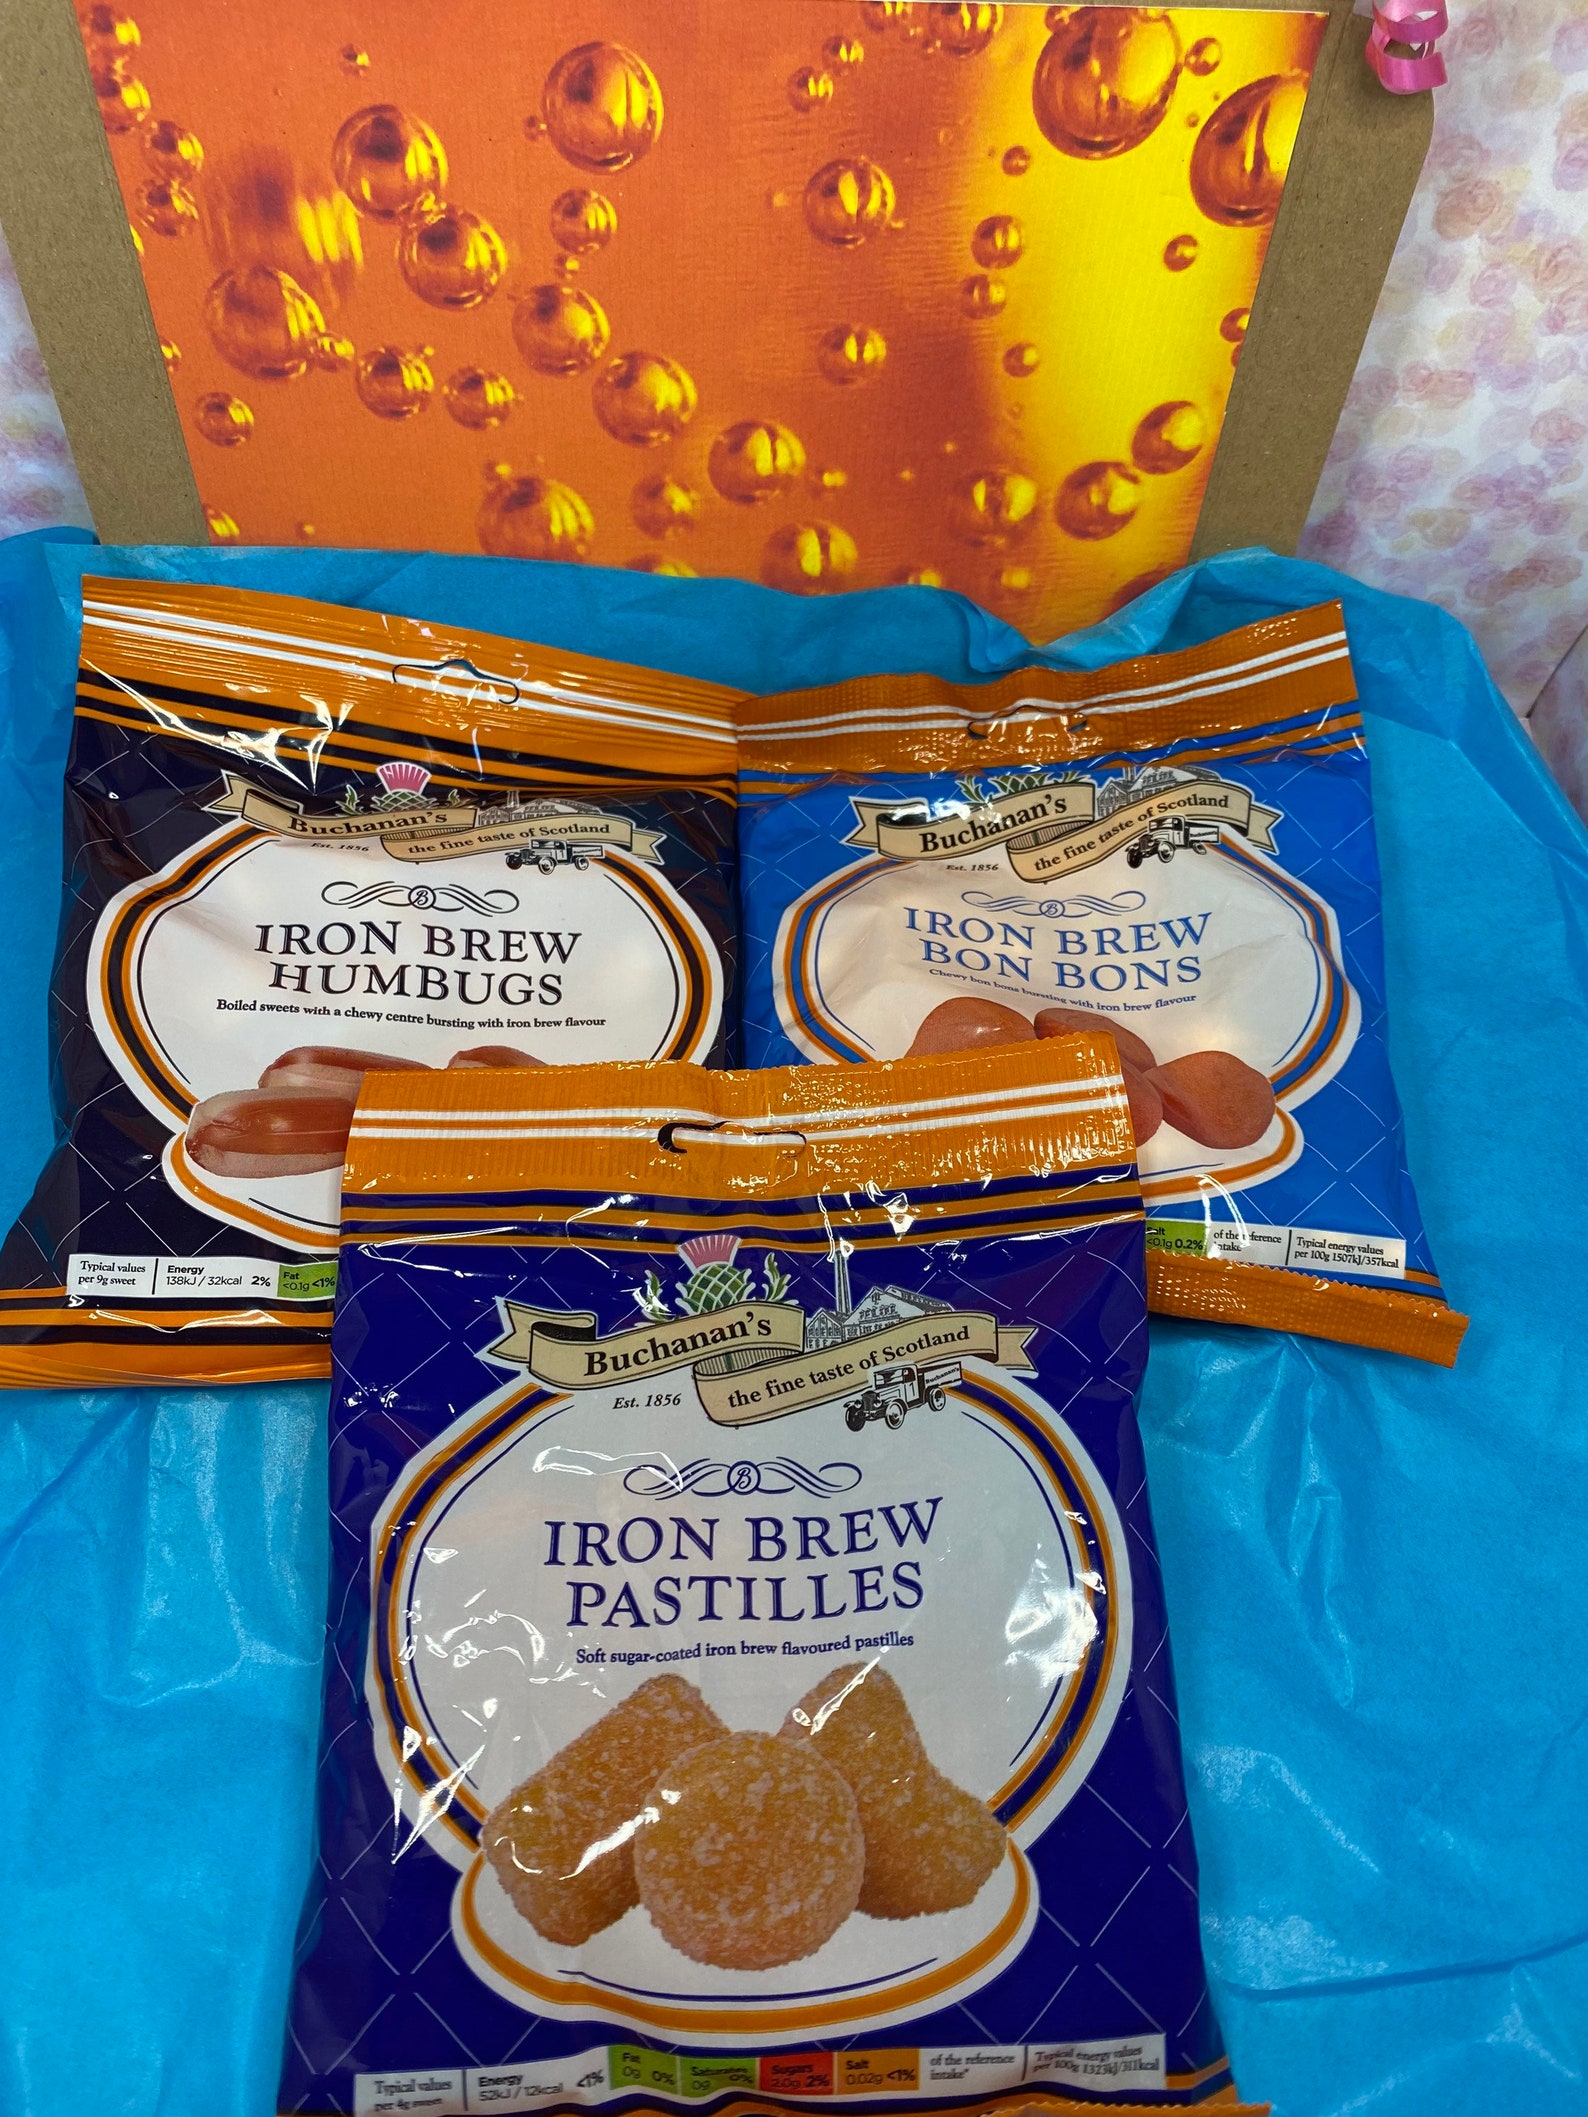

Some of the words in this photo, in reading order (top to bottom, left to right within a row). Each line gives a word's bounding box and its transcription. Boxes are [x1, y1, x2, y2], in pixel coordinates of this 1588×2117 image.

[288, 812, 448, 835] Buchanan's
[919, 794, 1067, 853] Buchanan's
[408, 843, 436, 854] the
[440, 839, 474, 851] fine
[478, 833, 517, 845] taste
[519, 826, 537, 838] of
[540, 824, 611, 836] Scotland
[1034, 857, 1061, 871] the
[1063, 840, 1096, 861] fine
[1098, 819, 1134, 843] taste
[1138, 807, 1155, 822] of
[1157, 795, 1229, 813] Scotland
[339, 844, 370, 852] 1856
[970, 864, 999, 872] 1856
[903, 907, 1036, 951] IRON
[1055, 912, 1213, 957] BREW
[254, 920, 402, 956] IRON
[424, 924, 582, 964] BREW
[918, 938, 1032, 982] BON
[1052, 956, 1202, 992] BONS
[268, 961, 565, 1006] HUMBUGS
[929, 968, 967, 984] Chewy
[970, 975, 991, 987] bon
[994, 981, 1019, 993] bons
[1022, 988, 1067, 1004] bursting
[1069, 998, 1095, 1009] with
[1097, 1002, 1120, 1011] iron
[1123, 1002, 1152, 1012] brew
[1155, 994, 1197, 1009] flavour
[216, 998, 257, 1011] Boiled
[260, 1002, 300, 1014] sweets
[303, 1006, 331, 1016] with
[344, 1007, 383, 1022] chewy
[386, 1012, 424, 1024] centre
[426, 1014, 475, 1030] bursting
[477, 1018, 504, 1028] with
[506, 1018, 531, 1028] iron
[534, 1018, 563, 1028] brew
[565, 1017, 606, 1027] flavour
[1214, 1229, 1224, 1239] of
[1225, 1230, 1239, 1240] the
[1146, 1238, 1172, 1249] <0.1g
[1175, 1239, 1203, 1250] 0.2%
[1297, 1236, 1326, 1250] Typical
[1328, 1242, 1356, 1255] energy
[1357, 1243, 1384, 1255] values
[80, 1260, 115, 1273] Typical
[117, 1262, 146, 1273] values
[1294, 1251, 1308, 1262] per
[1310, 1250, 1331, 1263] 100g
[1332, 1252, 1399, 1269] 1507kJ/357kcal
[167, 1265, 204, 1276] Energy
[283, 1271, 300, 1280] Fat
[78, 1275, 94, 1285] per
[96, 1274, 108, 1286] 9g
[109, 1275, 136, 1285] sweet
[166, 1275, 197, 1286] 138kJ
[207, 1275, 242, 1286] 32kcal
[251, 1276, 271, 1287] 2%
[282, 1280, 310, 1292] <0.1g
[312, 1276, 336, 1288] <1%
[583, 1311, 773, 1377] Buchanan's
[727, 1388, 763, 1410] the
[766, 1373, 806, 1402] fine
[809, 1358, 854, 1386] taste
[859, 1351, 880, 1370] of
[882, 1326, 970, 1361] Scotland
[612, 1396, 642, 1411] Est.
[645, 1392, 682, 1408] 1856
[543, 1516, 721, 1568] IRON
[744, 1496, 944, 1563] BREW
[565, 1560, 926, 1628] PASTILLES
[576, 1648, 607, 1665] Soft
[610, 1642, 702, 1666] sugar-coated
[705, 1642, 737, 1656] iron
[740, 1640, 778, 1655] brew
[781, 1636, 851, 1656] flavoured
[855, 1631, 915, 1651] pastilles
[622, 2053, 641, 2064] Fat
[930, 2053, 943, 2067] of
[944, 2053, 962, 2066] the
[965, 2053, 1015, 2065] reference
[1035, 2050, 1075, 2063] Typical
[1076, 2051, 1111, 2063] energy
[1113, 2046, 1142, 2059] values
[771, 2064, 813, 2077] Sugars
[845, 2060, 869, 2070] Salt
[1033, 2063, 1051, 2073] per
[1054, 2060, 1080, 2073] 100g
[576, 2070, 605, 2088] <1%
[622, 2066, 641, 2079] 0g
[652, 2071, 675, 2086] 0%
[729, 2074, 754, 2085] 0%
[846, 2073, 882, 2086] 0.02g
[886, 2069, 916, 2082] <1%
[374, 2079, 416, 2096] Typical
[418, 2077, 452, 2092] values
[478, 2074, 523, 2088] Energy
[692, 2080, 710, 2091] 0g
[806, 2075, 829, 2087] 2%
[479, 2089, 513, 2101] 52kJ
[524, 2083, 563, 2097] 12kcal
[374, 2101, 394, 2112] per
